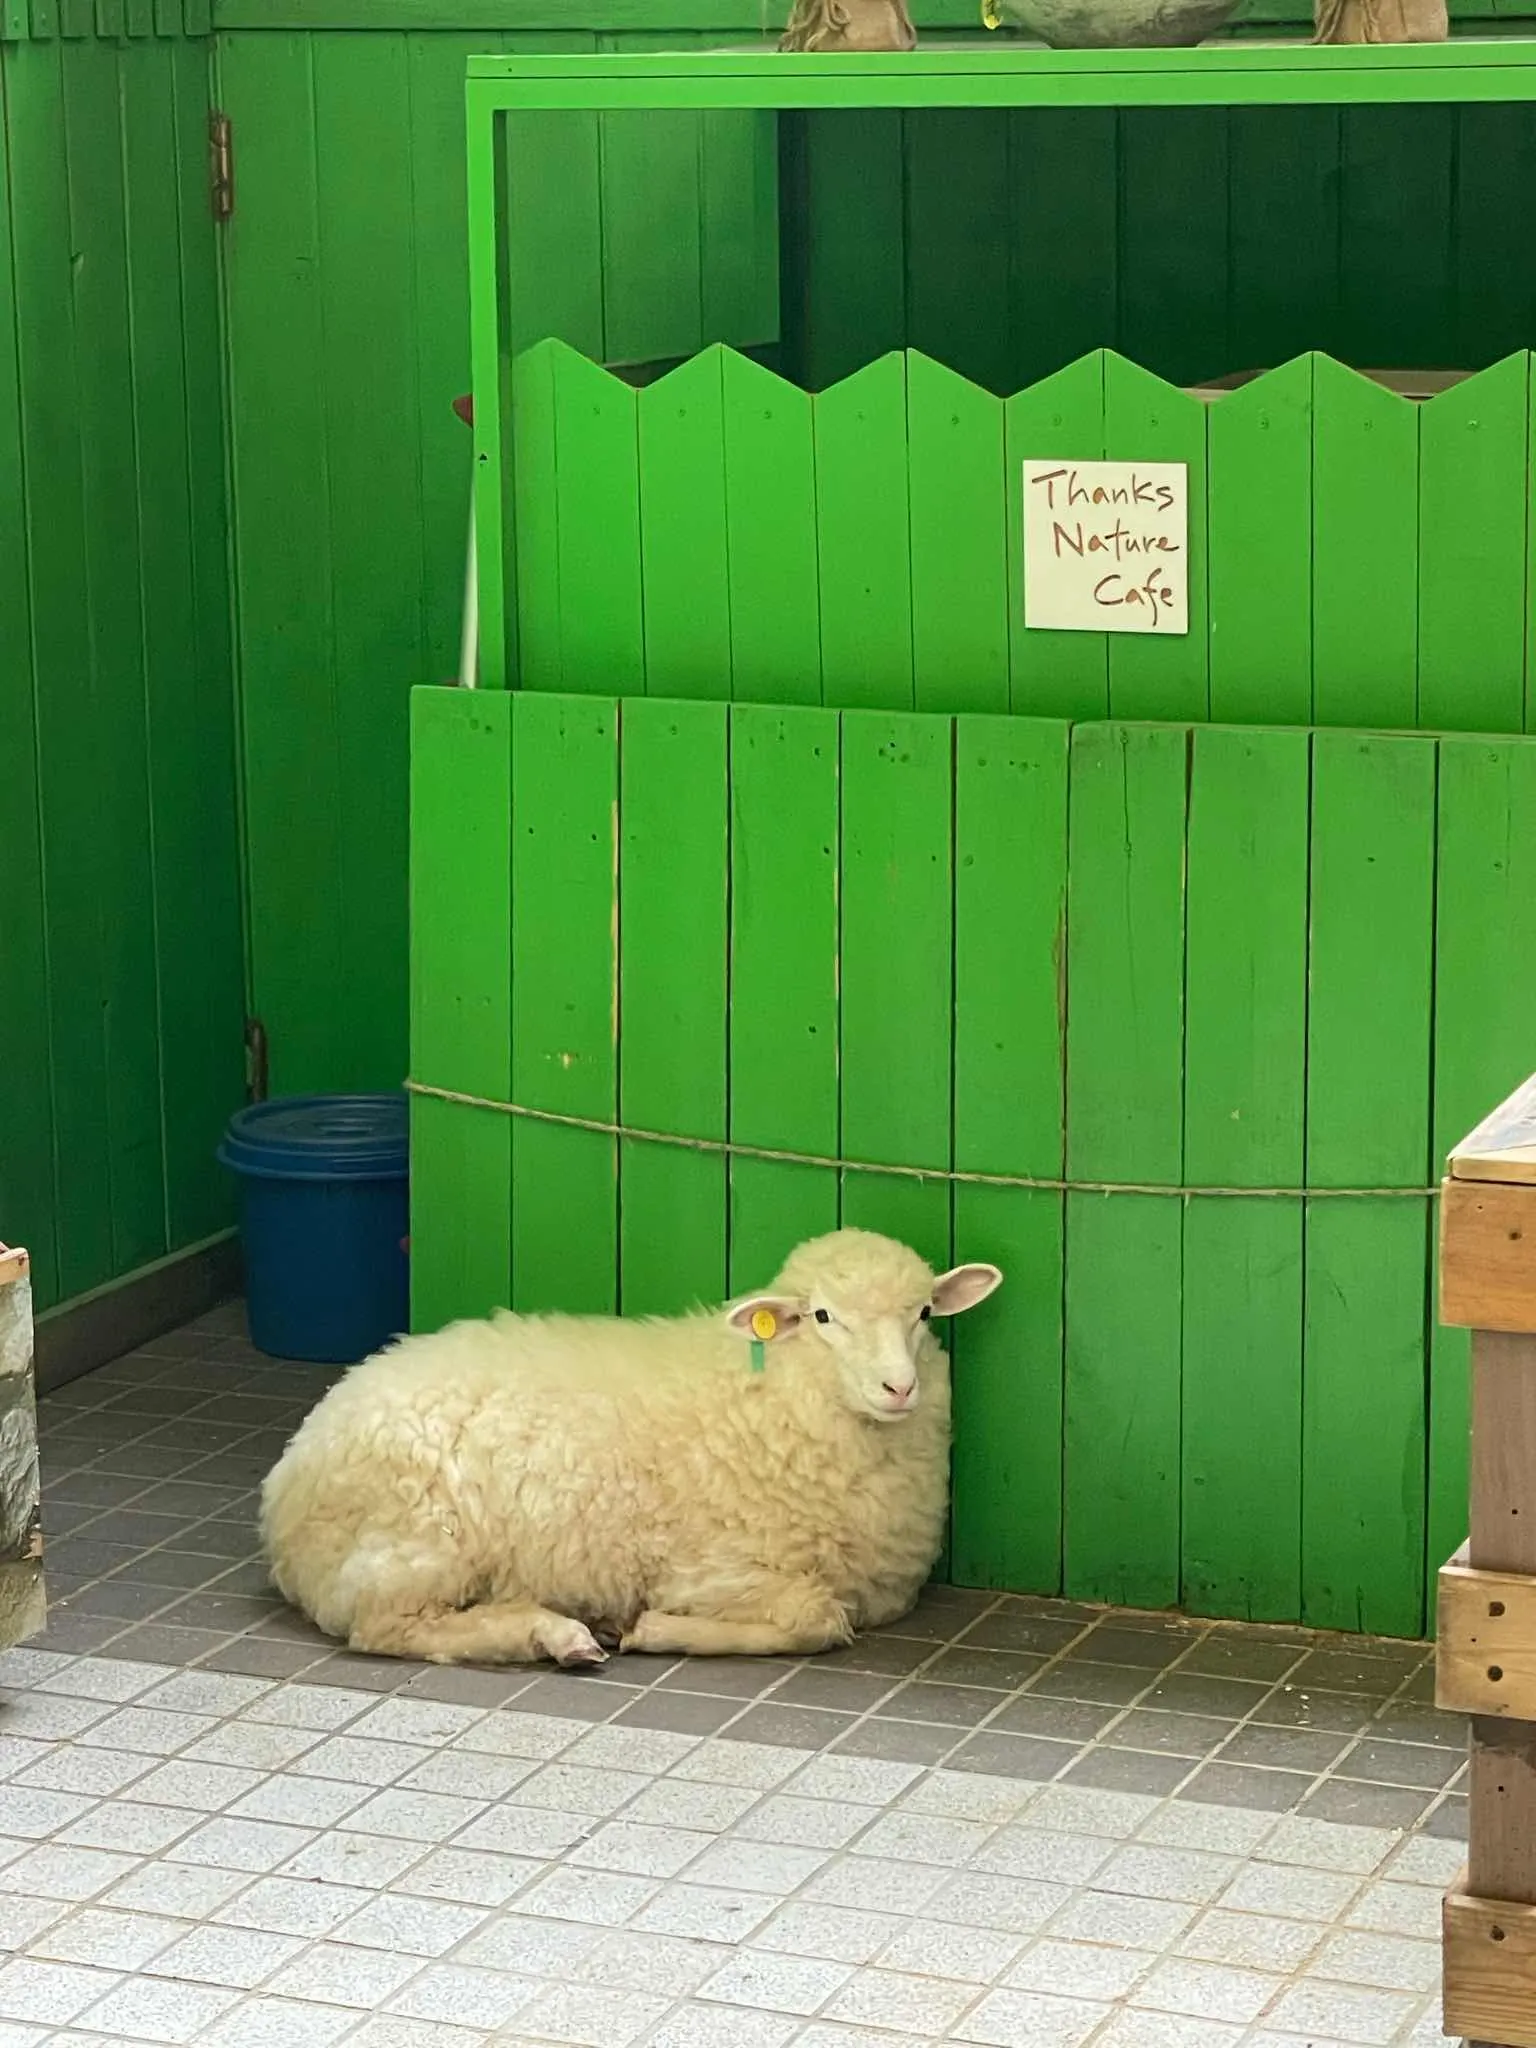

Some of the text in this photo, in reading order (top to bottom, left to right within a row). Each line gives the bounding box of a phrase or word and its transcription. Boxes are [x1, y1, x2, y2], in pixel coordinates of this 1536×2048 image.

[1032, 469, 1174, 511] Thanks
[1053, 518, 1180, 561] Nature
[1094, 567, 1174, 626] Cafe
